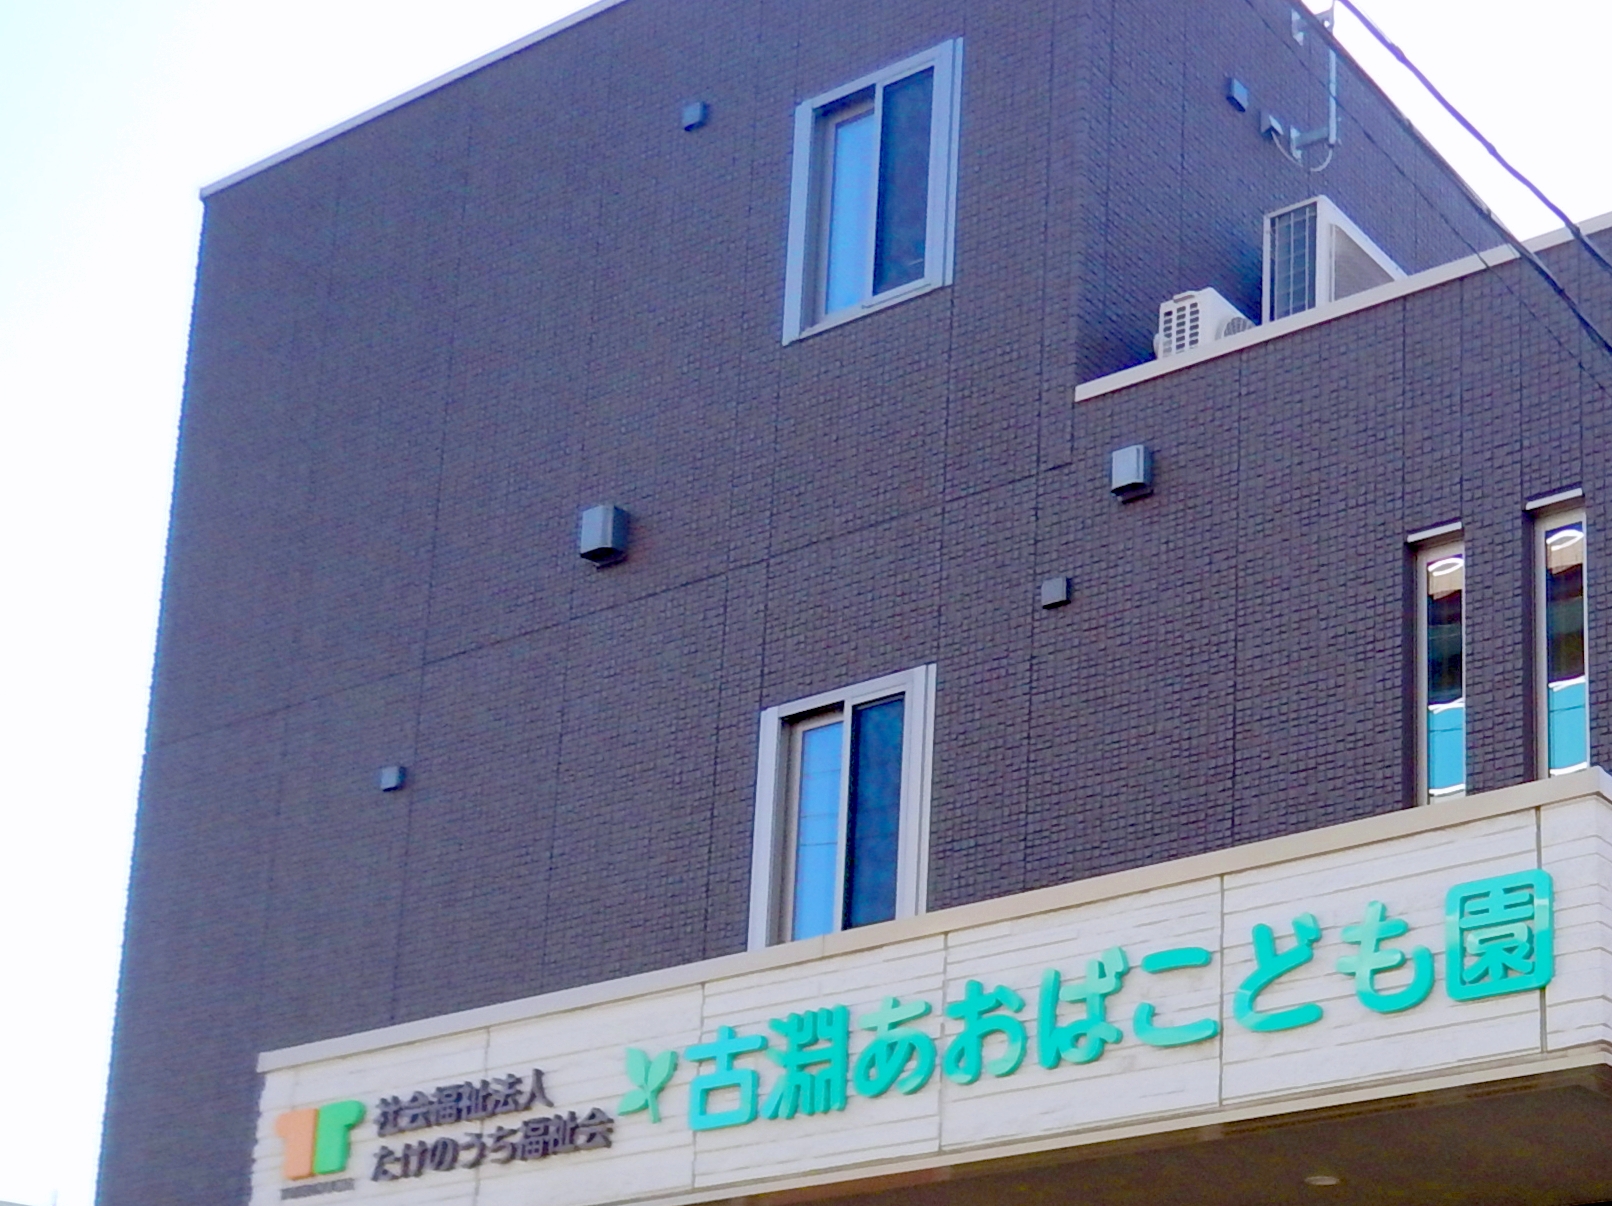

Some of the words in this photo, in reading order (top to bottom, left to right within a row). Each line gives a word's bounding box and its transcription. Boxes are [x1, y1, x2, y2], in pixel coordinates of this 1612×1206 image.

[682, 868, 1554, 1131] 古淵あおばこども園
[374, 1068, 554, 1137] 社会福祉法人
[372, 1108, 614, 1181] たけのうち福祉会
